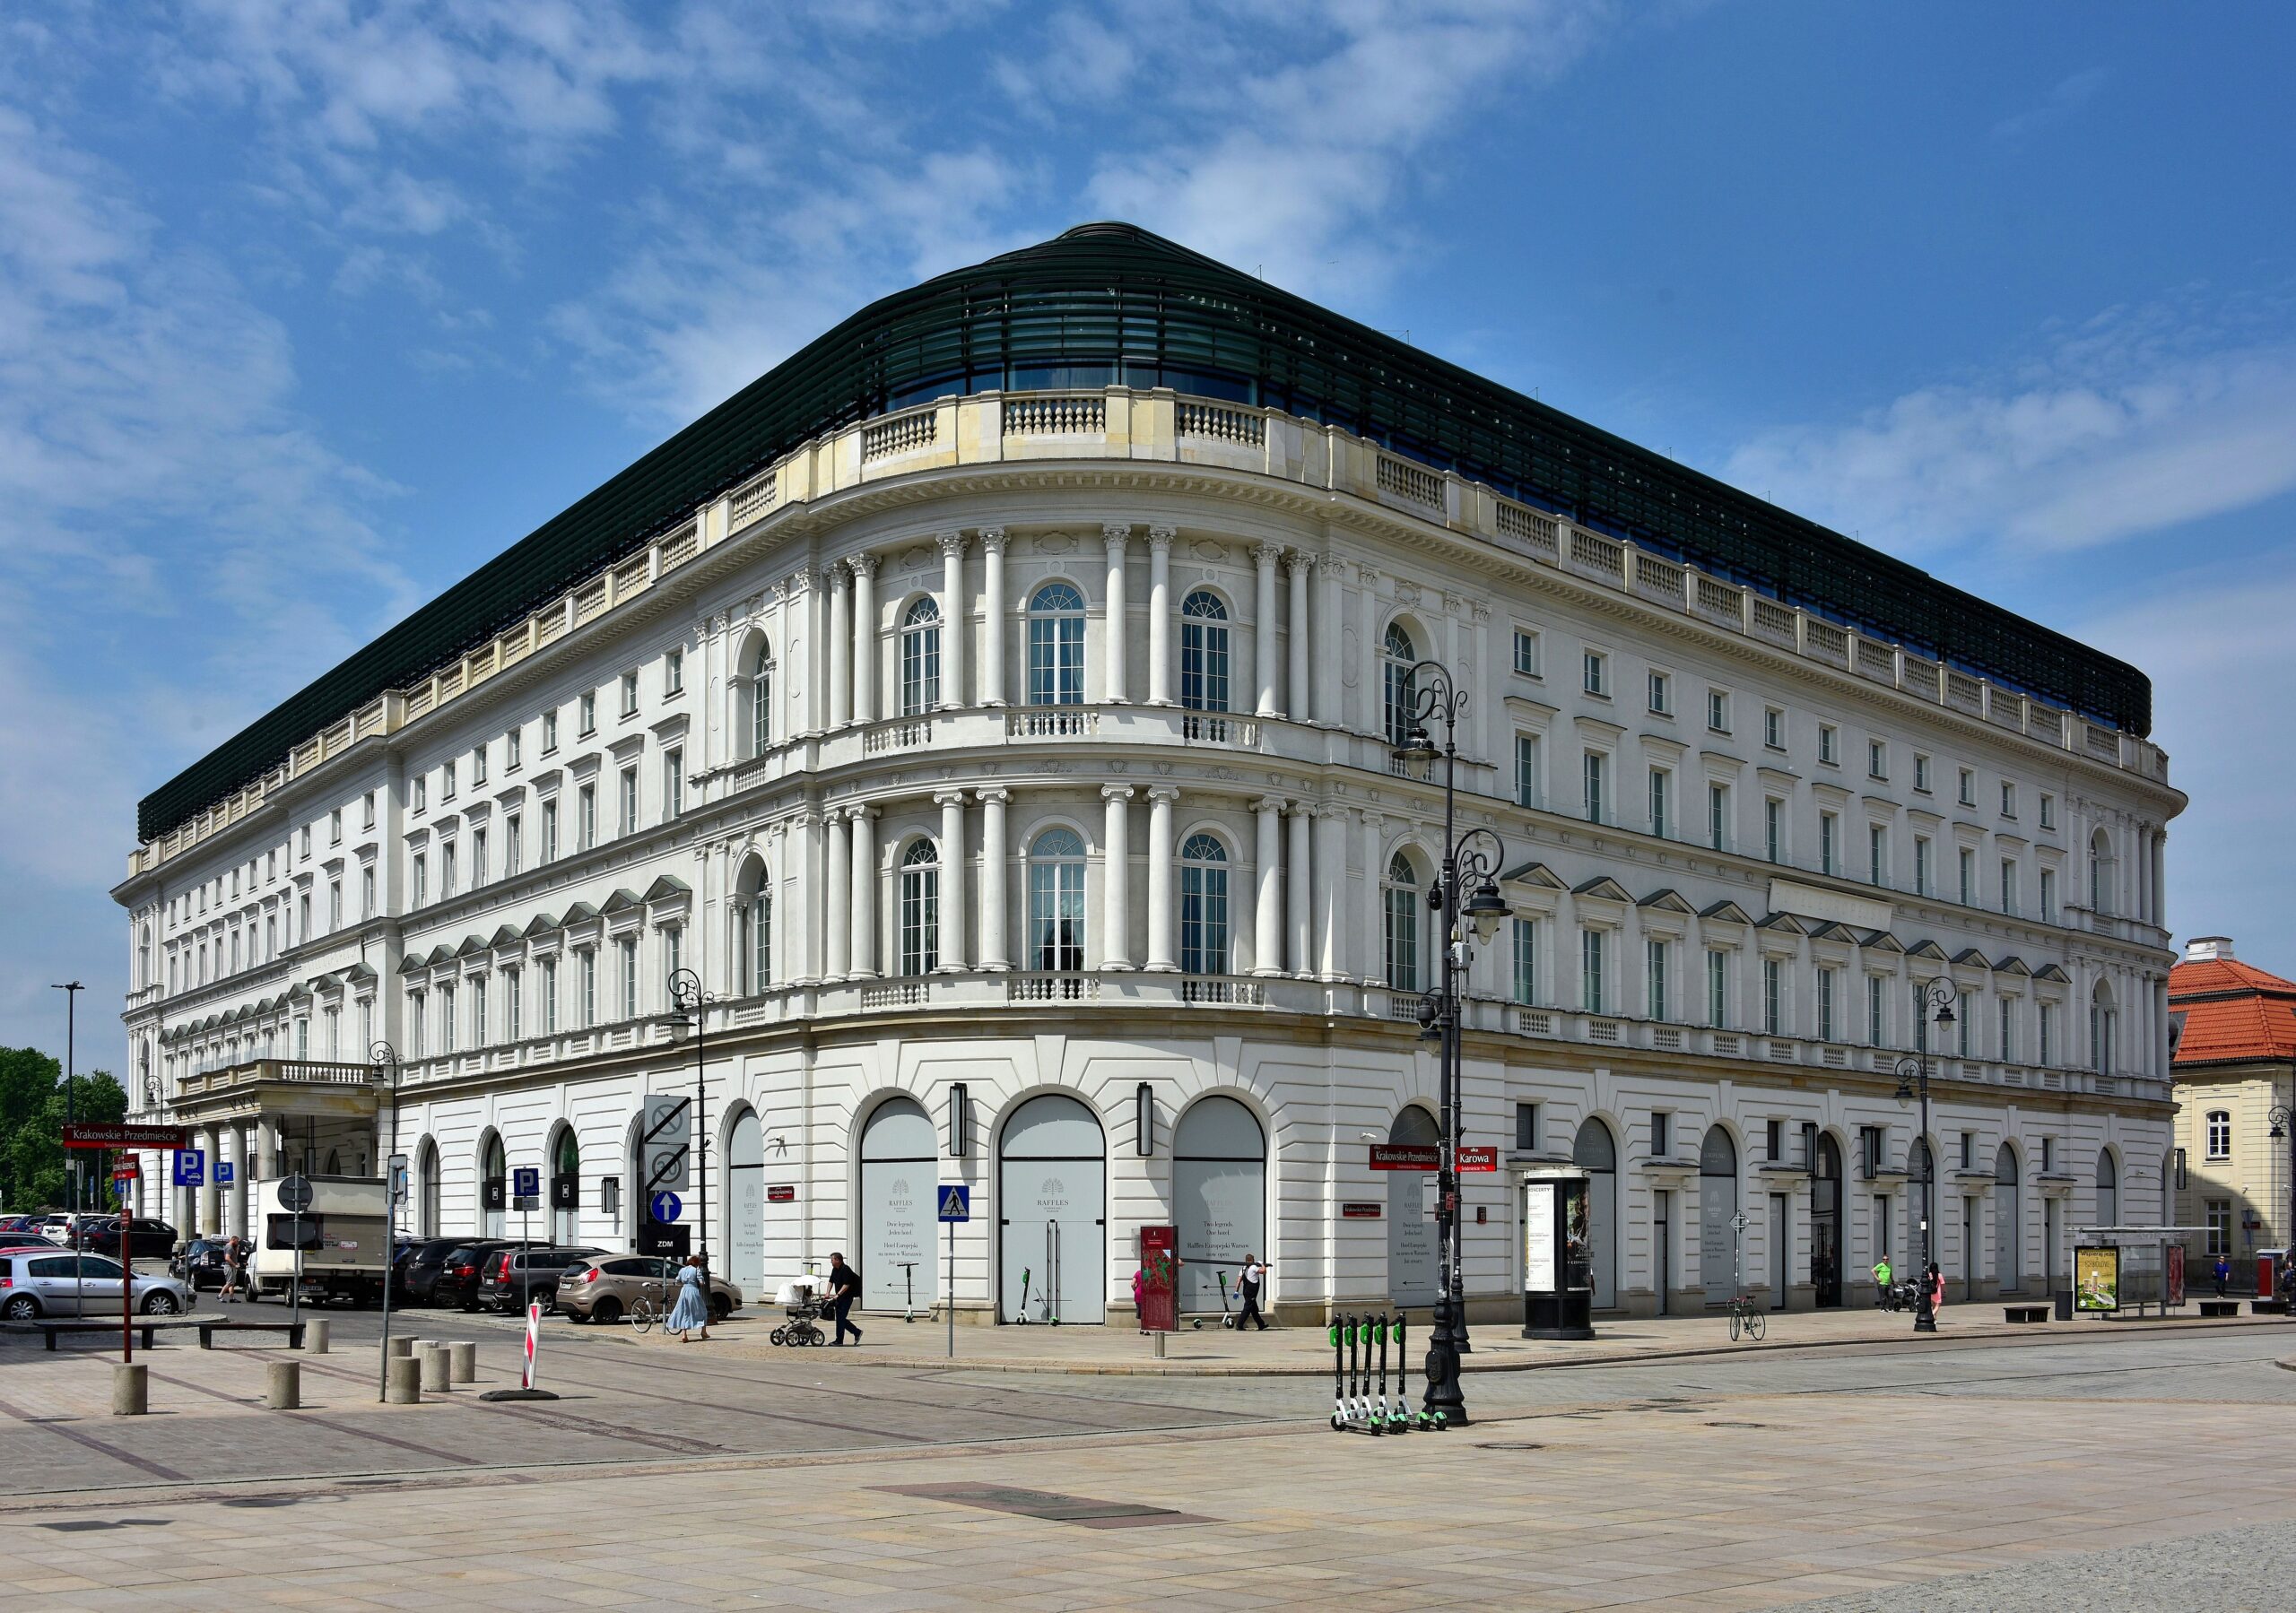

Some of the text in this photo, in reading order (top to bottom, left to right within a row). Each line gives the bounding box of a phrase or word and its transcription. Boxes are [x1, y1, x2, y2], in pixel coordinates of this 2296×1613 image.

[74, 1130, 178, 1141] Krakowskie Przedmieście
[1376, 1150, 1439, 1163] Krakowskie Przedmieście
[1459, 1154, 1490, 1163] Karowa
[181, 1152, 198, 1175] P
[218, 1165, 230, 1180] P
[519, 1172, 534, 1193] P
[1205, 1243, 1231, 1251] Europejski
